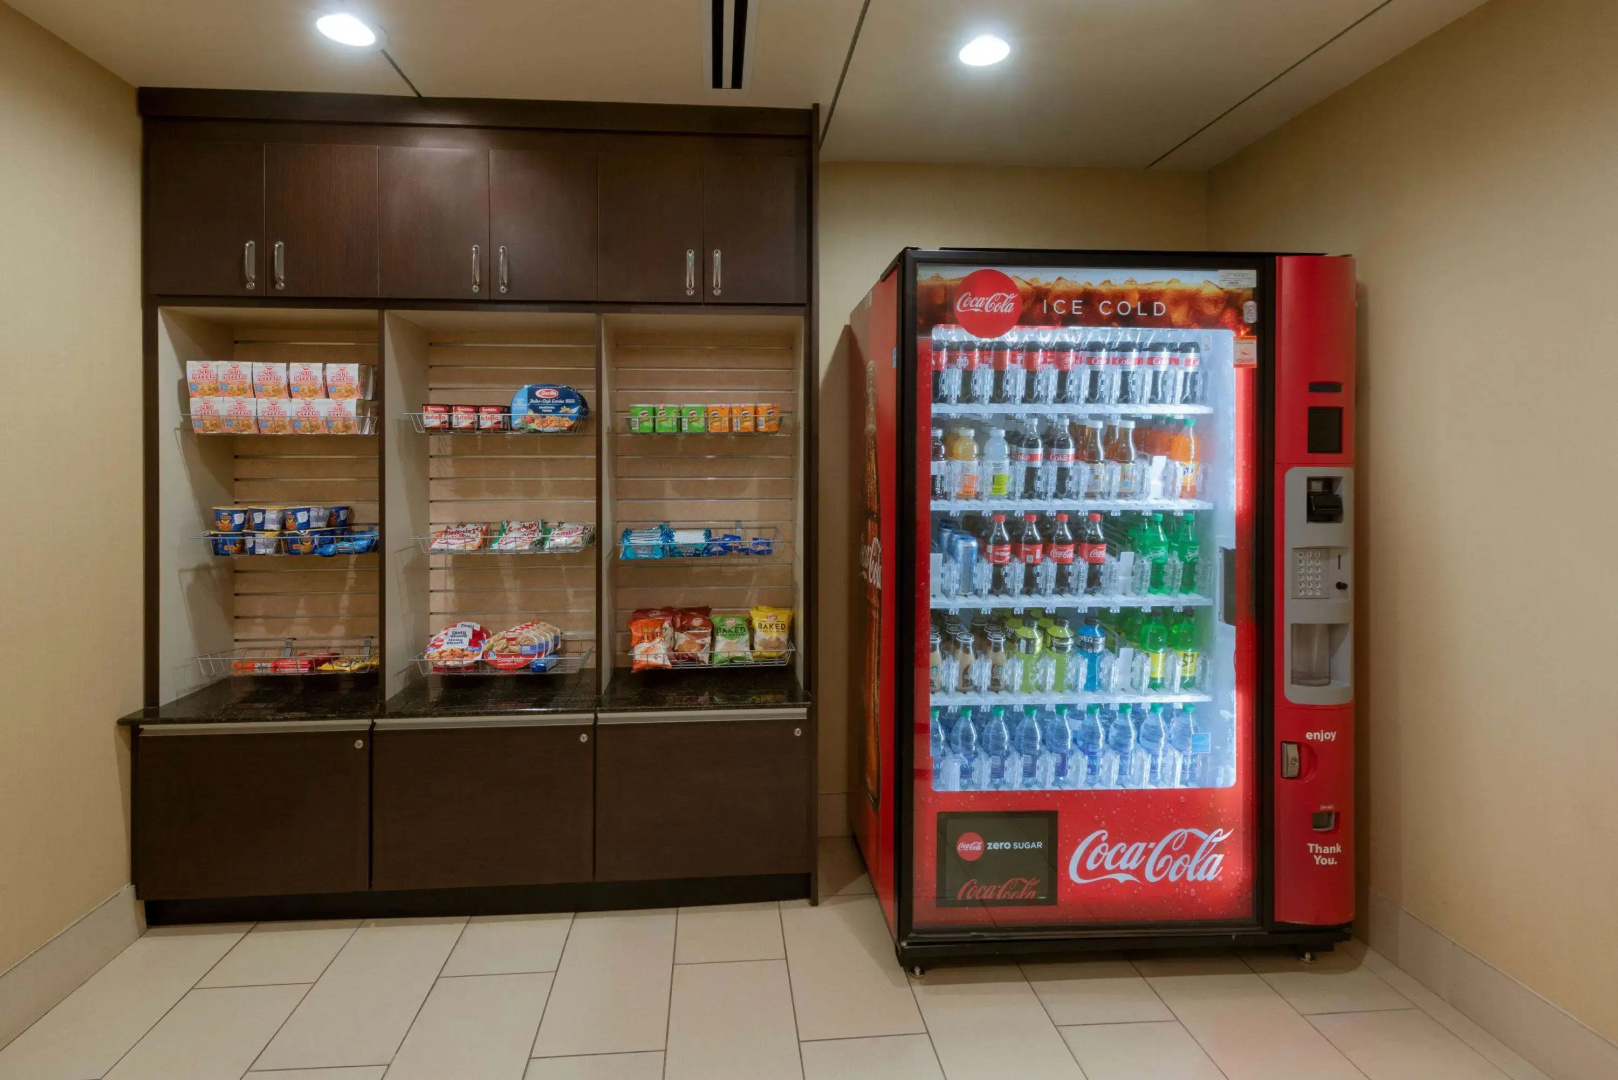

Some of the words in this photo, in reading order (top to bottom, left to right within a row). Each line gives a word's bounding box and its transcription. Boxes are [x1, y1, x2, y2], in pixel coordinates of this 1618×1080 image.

[955, 291, 1018, 313] Coca-Cola
[1043, 299, 1083, 315] ICE
[1099, 300, 1167, 317] COLD
[757, 622, 786, 630] BAKED
[1305, 730, 1337, 741] enjoy
[957, 841, 984, 851] Coca-Cola
[986, 841, 1011, 850] zero
[1012, 841, 1043, 849] SUGAR
[1307, 843, 1342, 854] Thank
[1068, 827, 1234, 884] Coca-Cola
[1313, 855, 1338, 866] You.
